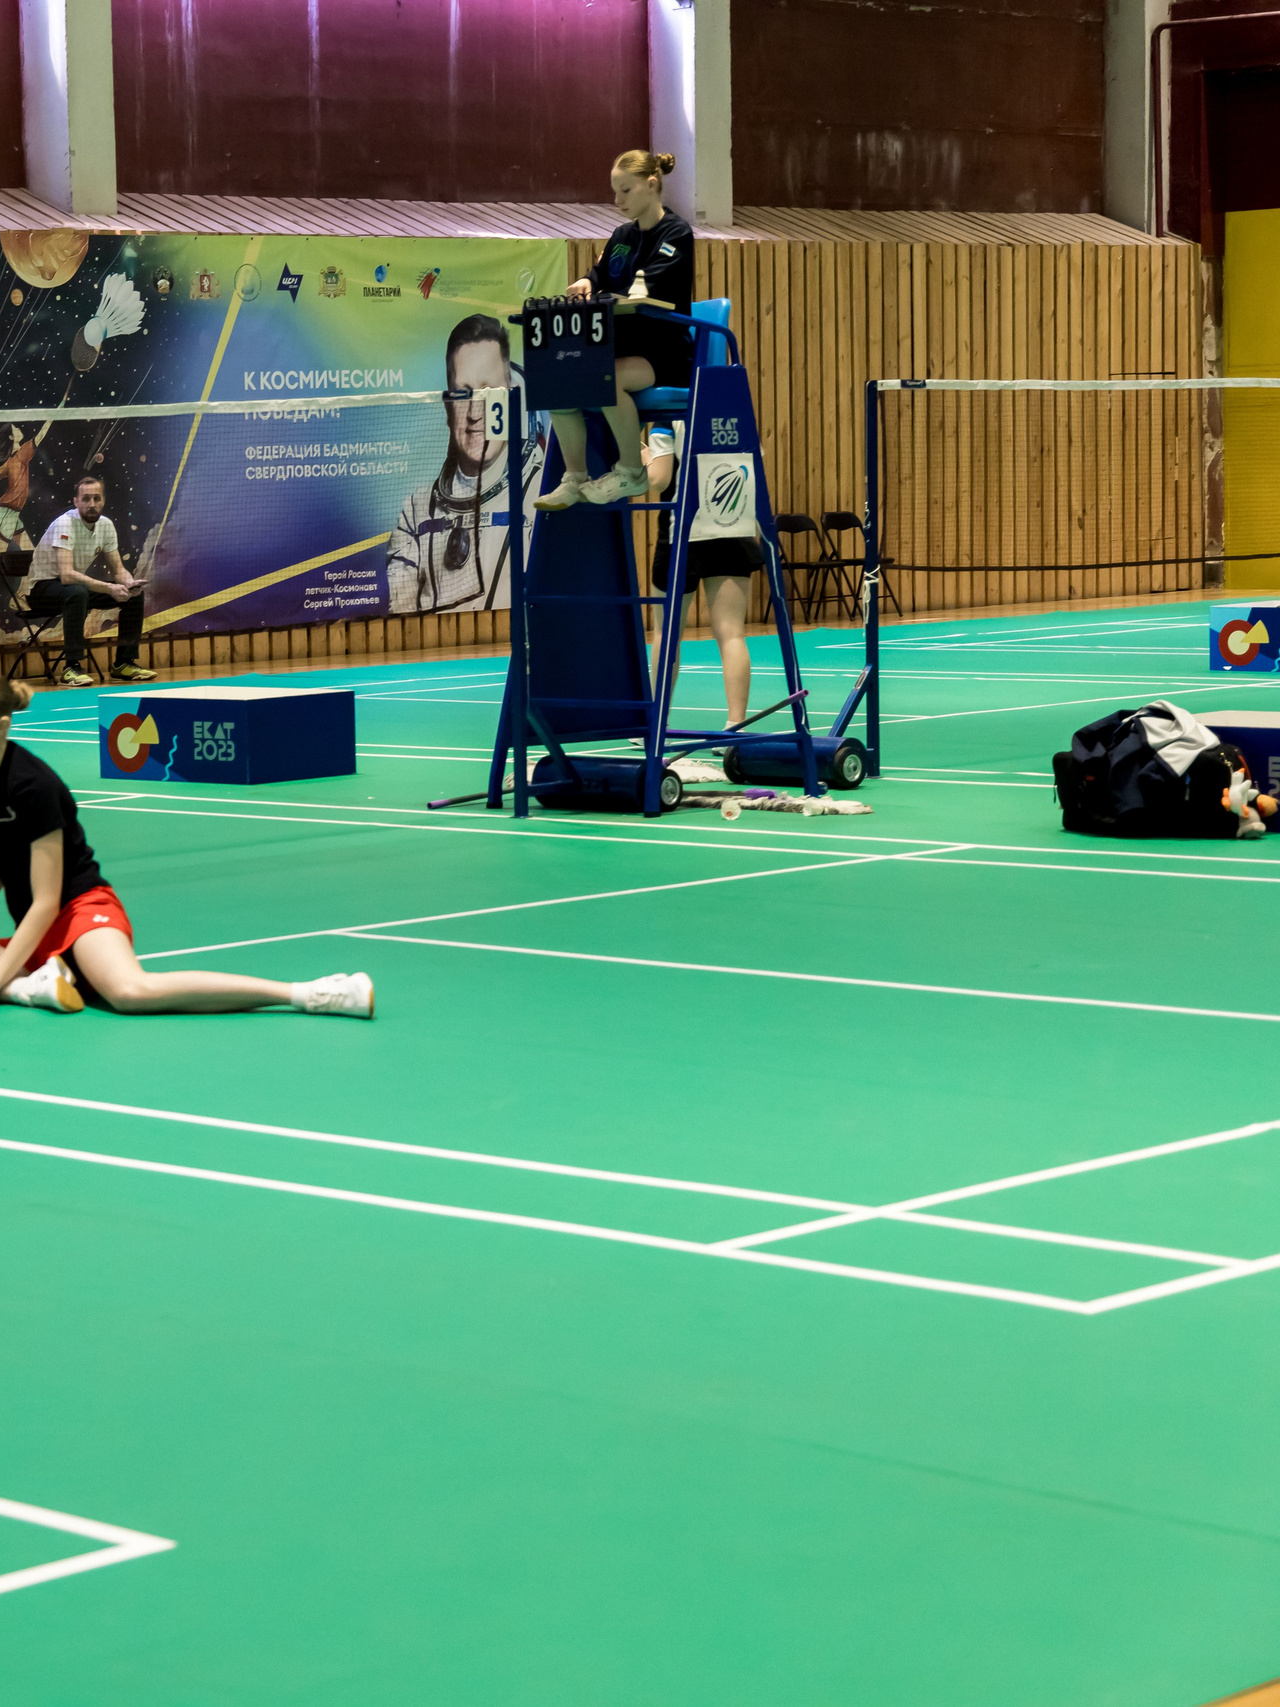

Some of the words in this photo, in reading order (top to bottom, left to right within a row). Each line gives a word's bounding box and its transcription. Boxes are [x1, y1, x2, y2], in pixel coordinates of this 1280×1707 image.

[363, 285, 401, 297] ПЛАНЕТАРИЙ
[531, 316, 542, 347] 3
[553, 314, 563, 337] 0
[571, 313, 581, 335] 0
[592, 312, 603, 343] 5
[244, 371, 256, 390] К
[260, 369, 404, 390] КОСМИЧЕСКИМ
[491, 402, 503, 435] 3
[711, 417, 738, 430] EKAT
[711, 430, 738, 445] 2023
[245, 444, 320, 461] ФЕДЕРАЦИЯ
[324, 440, 410, 458] БАДМИНТОНА
[245, 460, 347, 481] СВЕРДЛОВСКОЙ
[350, 461, 408, 476] ОБЛАСТИ
[324, 570, 347, 581] Герой
[348, 569, 376, 579] России
[305, 583, 378, 595] летчик-Космонавт
[304, 597, 333, 610] Сергей
[335, 596, 379, 608] Прокопьев
[193, 721, 235, 739] EKAT
[193, 740, 235, 761] 2023
